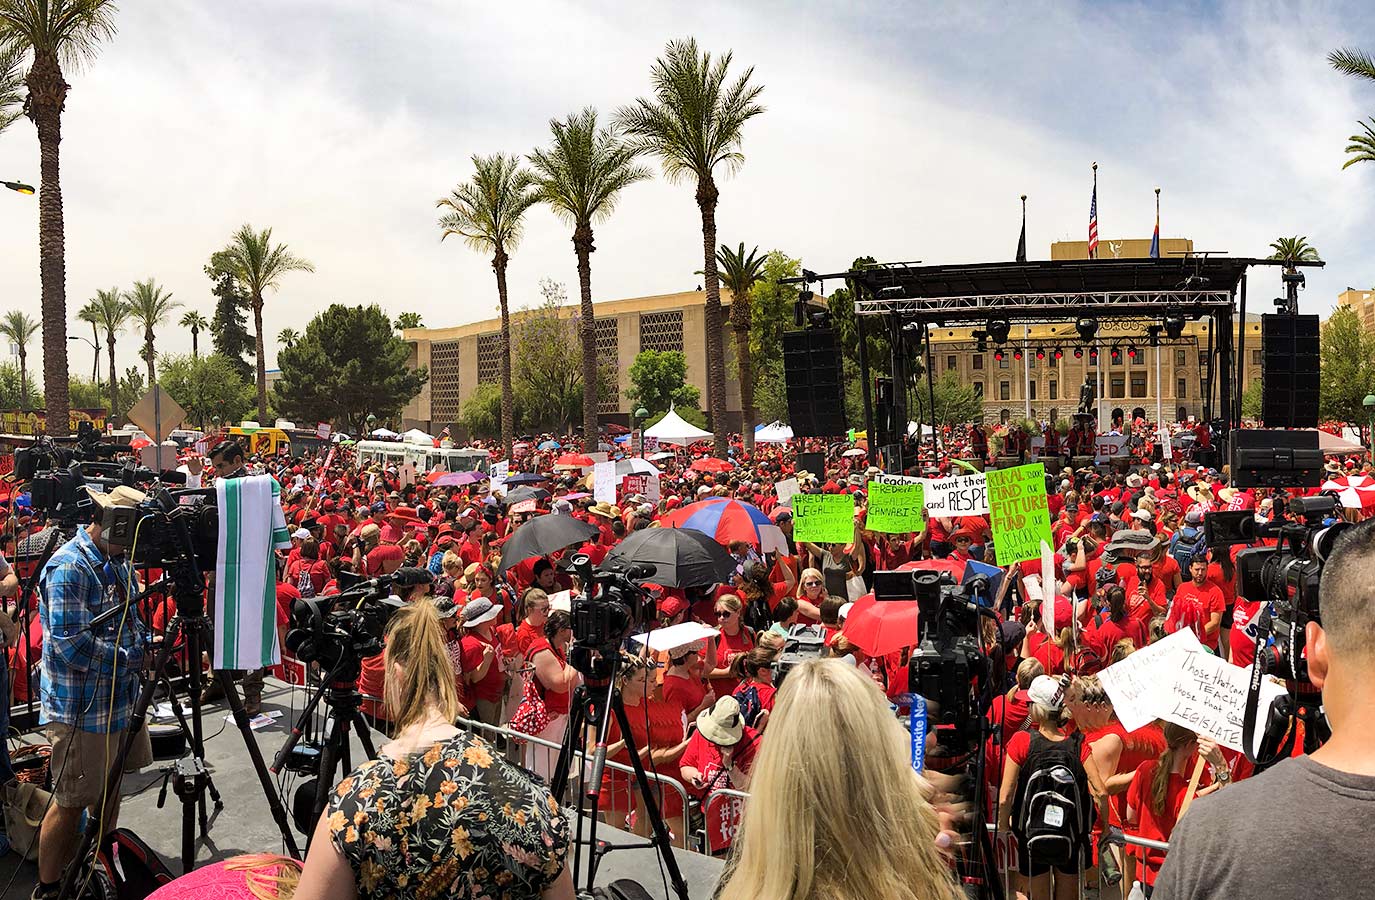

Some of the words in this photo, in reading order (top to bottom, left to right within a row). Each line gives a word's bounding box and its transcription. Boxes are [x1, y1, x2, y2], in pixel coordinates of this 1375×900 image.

[933, 478, 959, 491] want
[990, 484, 1022, 500] FUND
[926, 497, 945, 509] and
[992, 494, 1048, 517] FUTURE
[994, 514, 1026, 534] FUND
[1182, 648, 1210, 680] Those
[1213, 666, 1231, 689] that
[1174, 682, 1197, 702] those
[1204, 696, 1222, 713] that
[913, 720, 925, 770] Cronkite
